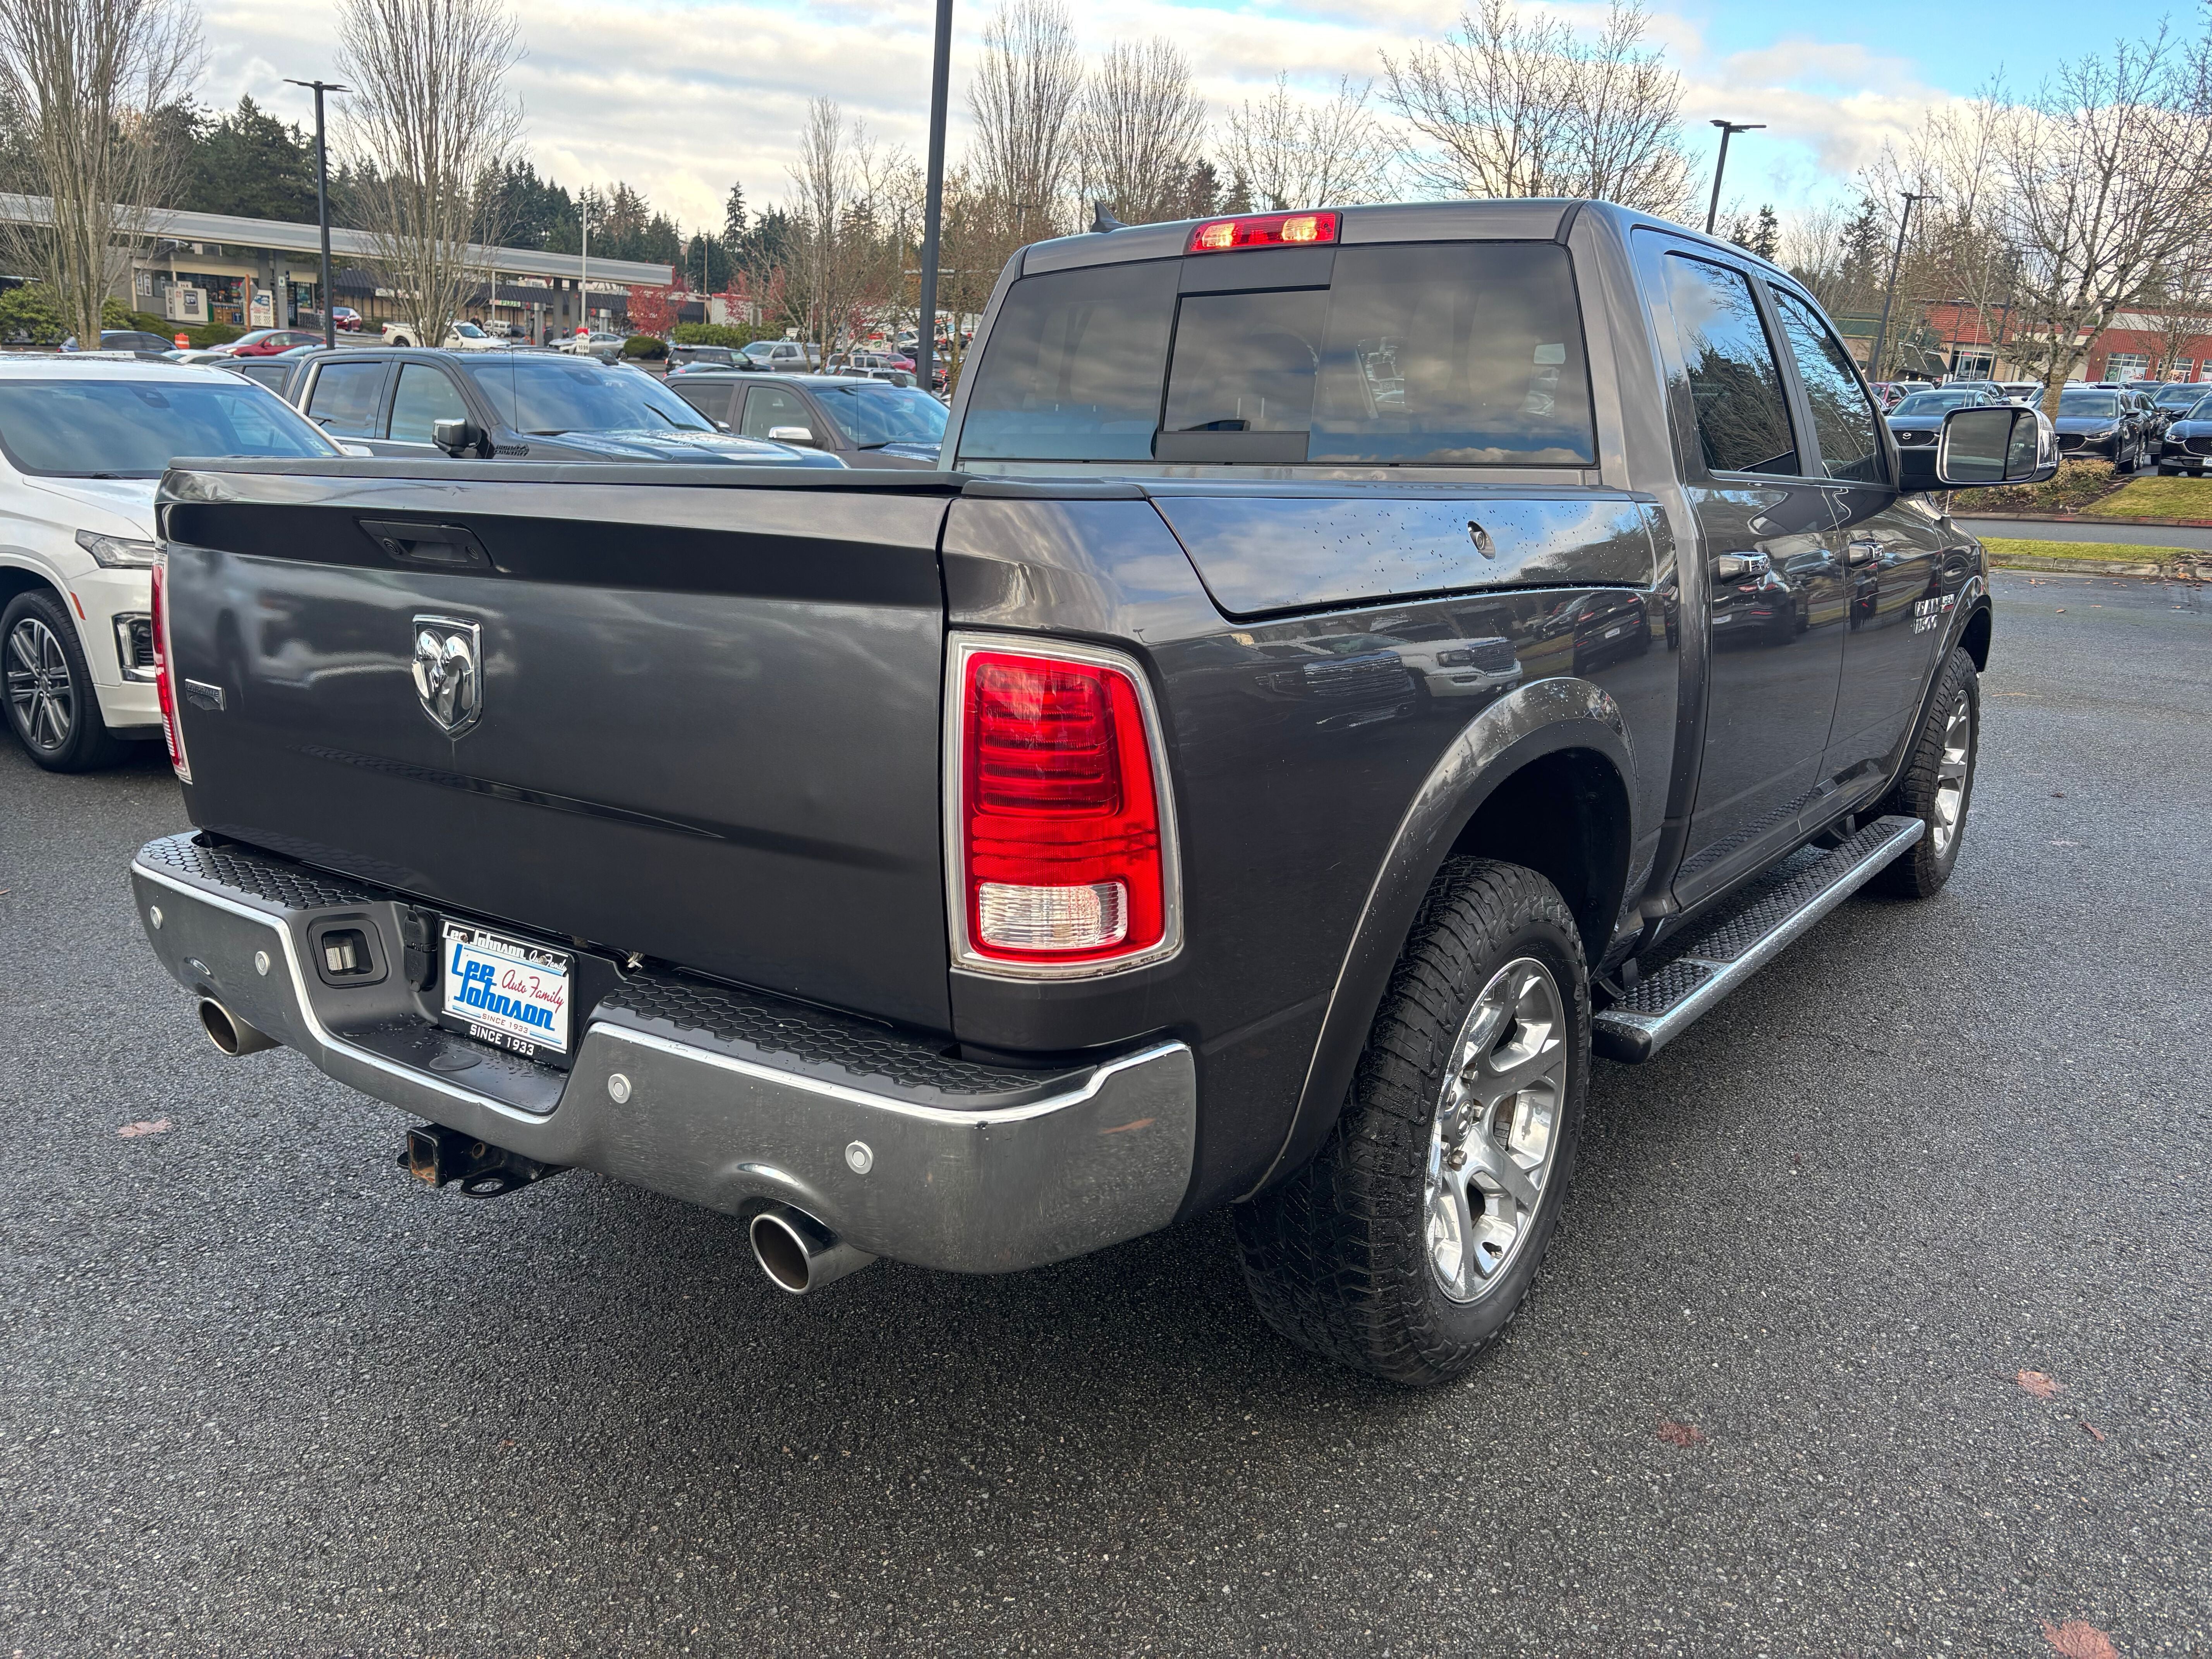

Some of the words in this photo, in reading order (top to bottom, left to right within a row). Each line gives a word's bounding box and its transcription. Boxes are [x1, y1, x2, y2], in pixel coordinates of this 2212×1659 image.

[452, 943, 496, 981] Lee
[470, 929, 526, 960] Johnson
[529, 950, 546, 965] Au
[544, 954, 567, 973] Family
[453, 976, 555, 1032] Johnson
[502, 969, 527, 993] Auto
[529, 976, 564, 1014] Family
[470, 1024, 503, 1045] SINCE
[507, 1037, 534, 1056] 1933
[482, 1013, 505, 1026] SINCE
[509, 1022, 529, 1034] 1933
